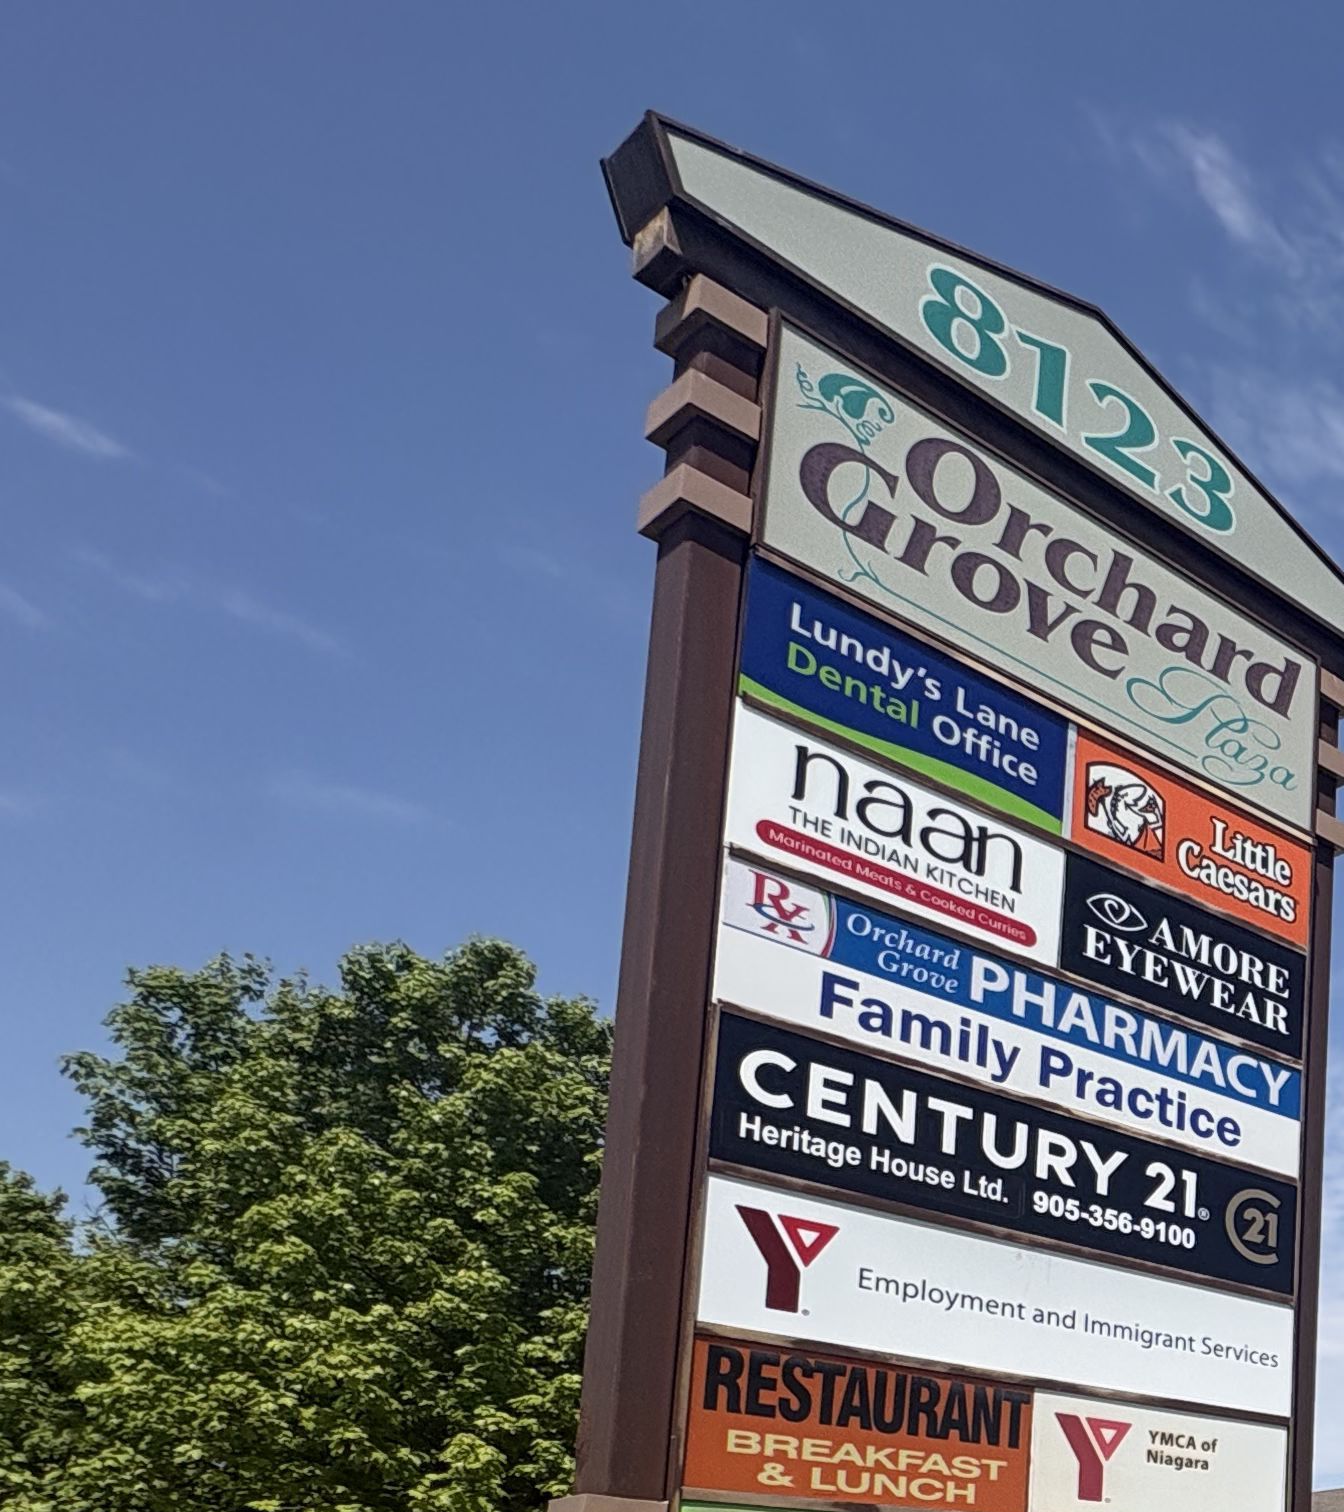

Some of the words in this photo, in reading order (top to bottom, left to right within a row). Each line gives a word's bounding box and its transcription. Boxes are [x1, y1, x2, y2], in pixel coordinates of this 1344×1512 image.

[920, 261, 1237, 535] 8123
[799, 442, 1130, 681] Grove
[905, 437, 1301, 720] Orchard
[786, 641, 920, 729] Dental
[932, 714, 1039, 786] Office
[789, 602, 942, 701] Lundy's
[956, 686, 1040, 751] Lane
[1126, 665, 1299, 792] Plaza
[788, 805, 833, 839] THE
[839, 828, 919, 875] INDIAN
[926, 858, 1016, 914] KITCHEN
[791, 744, 1023, 895] naan
[1210, 814, 1294, 886] Little
[769, 828, 853, 872] Marinated
[855, 864, 902, 890] Meats
[905, 882, 918, 895] &
[919, 888, 976, 921] Cooked
[977, 912, 1027, 941] Curries
[1176, 838, 1298, 924] Caesars
[846, 912, 961, 972] Orchard
[877, 942, 960, 995] Grove
[1081, 924, 1291, 1036] EYEWEAR
[1148, 916, 1291, 999] AMORE
[818, 972, 1021, 1083] Family
[1039, 1044, 1243, 1147] Practice
[969, 956, 1292, 1108] PHARMACY
[738, 1048, 1129, 1198] CENTURY
[738, 1112, 862, 1171] Heritage
[870, 1147, 956, 1191] House
[962, 1169, 1010, 1204] Ltd.
[1032, 1189, 1196, 1250] 905-356-9100
[858, 1267, 1027, 1322] Employment
[1032, 1303, 1076, 1331] and
[1083, 1312, 1196, 1354] Immigrant
[1201, 1336, 1280, 1369] Services
[703, 1345, 1034, 1449] RESTAURANT
[1148, 1429, 1197, 1452] YMCA
[1201, 1437, 1219, 1454] of
[726, 1428, 1008, 1482] BREAKFAST
[756, 1463, 795, 1489] &
[810, 1468, 977, 1505] LUNCH
[1145, 1448, 1210, 1472] Niagara
